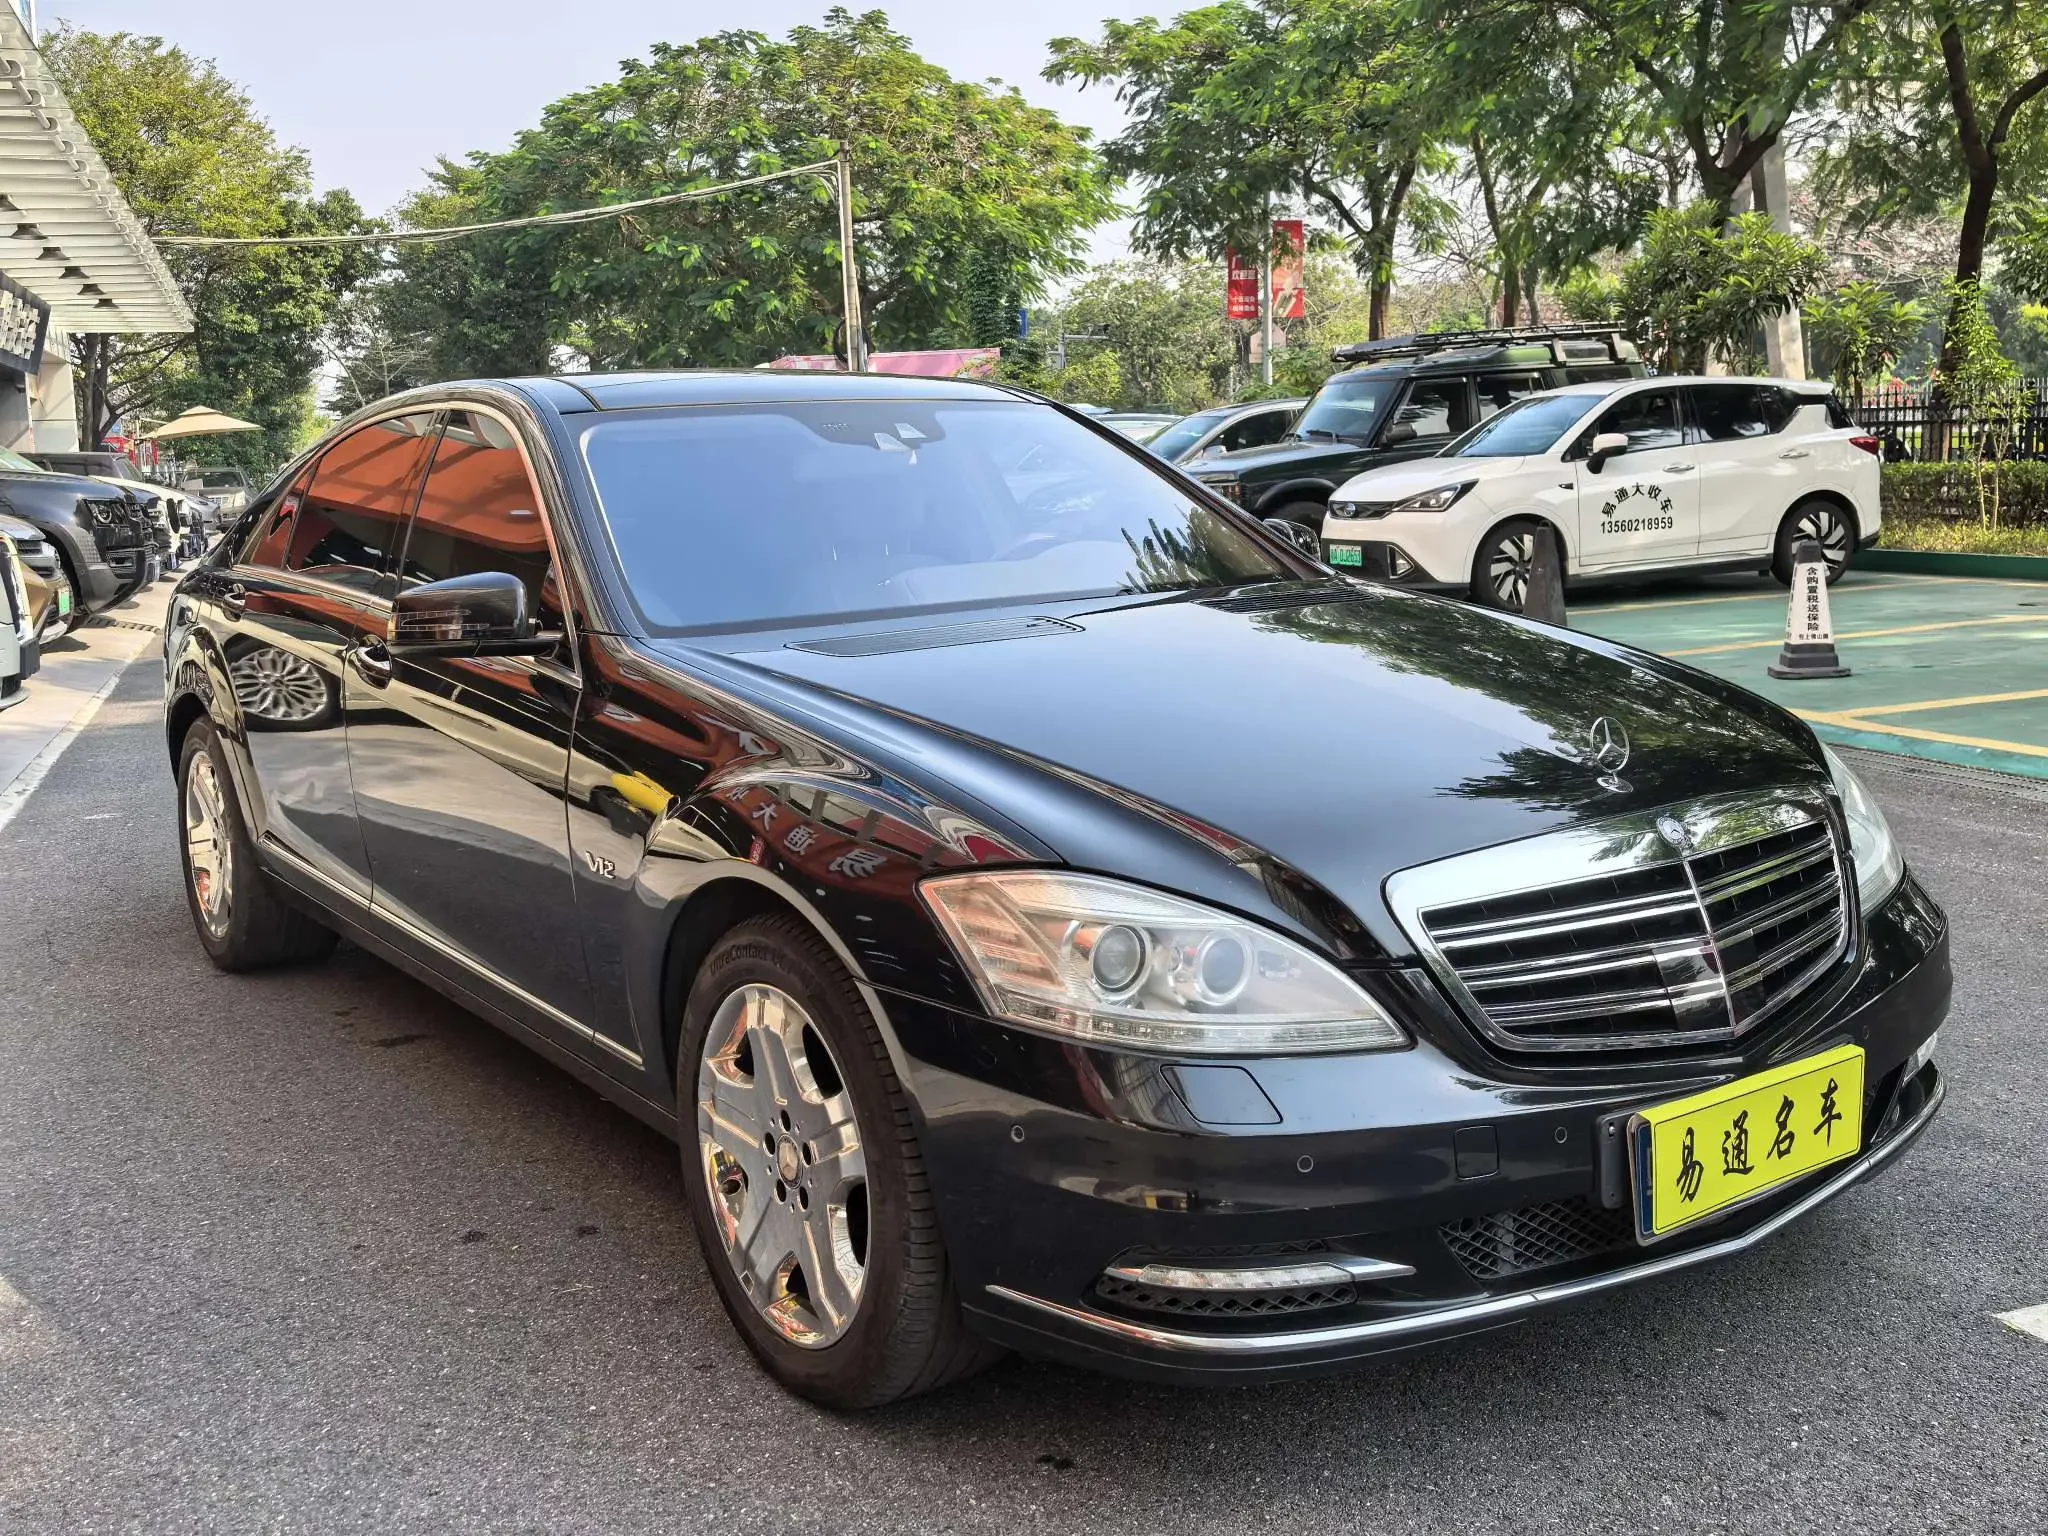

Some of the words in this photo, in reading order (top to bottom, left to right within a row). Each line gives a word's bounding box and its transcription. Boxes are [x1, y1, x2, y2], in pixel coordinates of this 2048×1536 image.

[1601, 482, 1673, 519] 易通大收车
[1600, 516, 1673, 534] 13560218959
[1806, 566, 1820, 631] 含购置税送保险
[585, 850, 616, 880] V12
[1675, 1077, 1843, 1205] 易通名车
